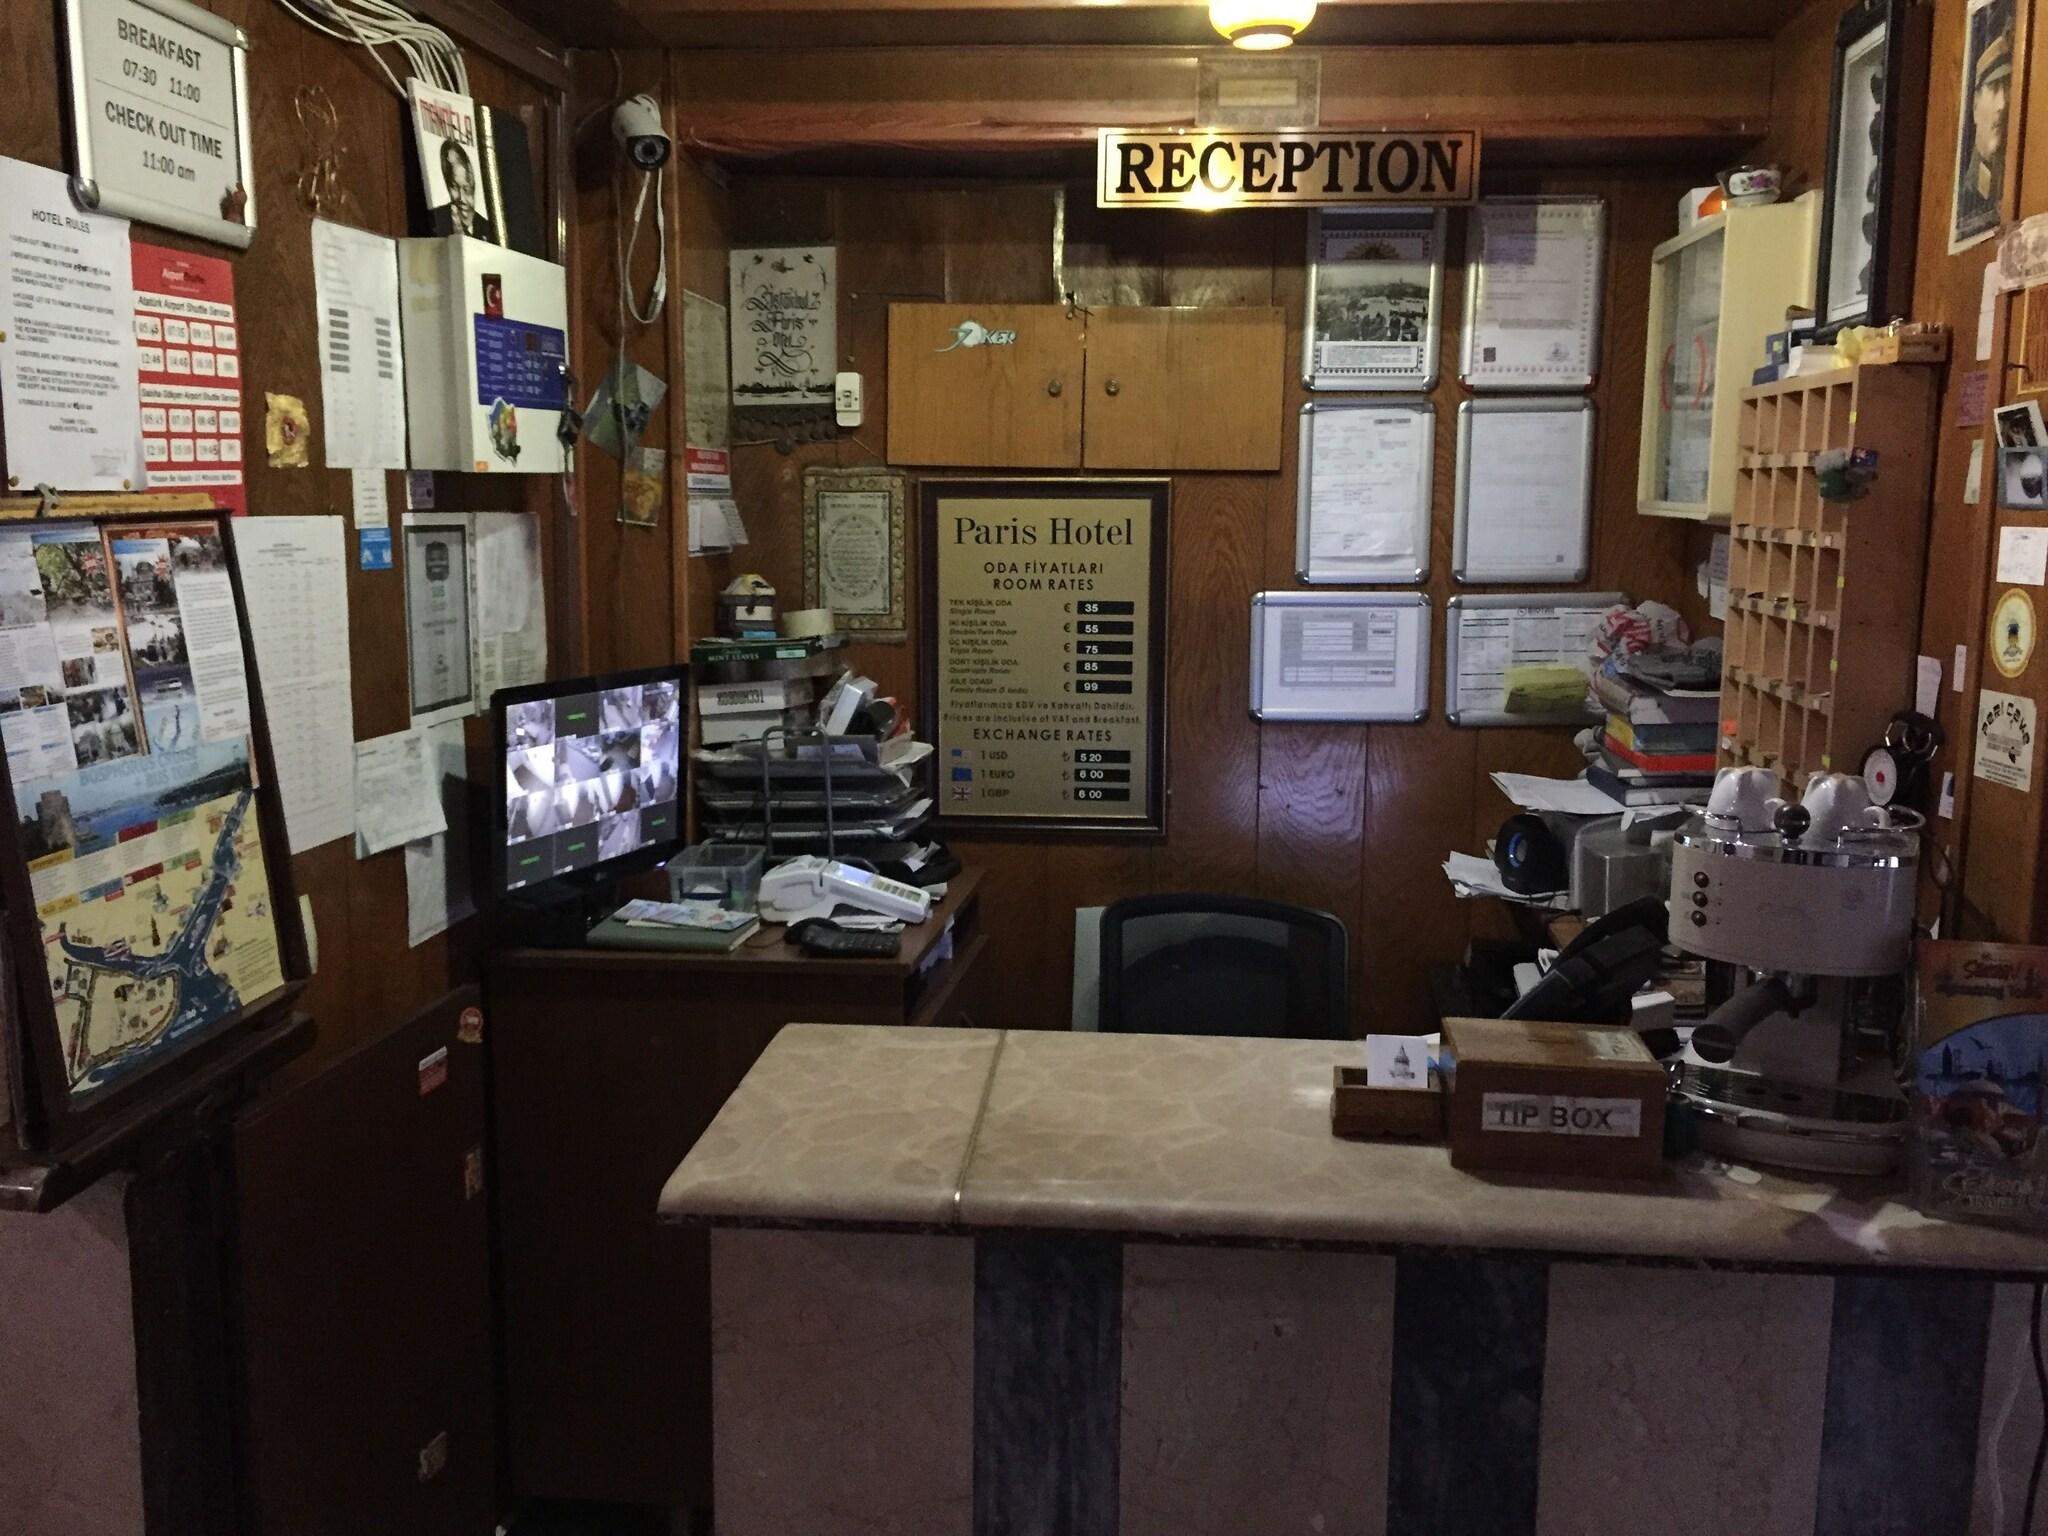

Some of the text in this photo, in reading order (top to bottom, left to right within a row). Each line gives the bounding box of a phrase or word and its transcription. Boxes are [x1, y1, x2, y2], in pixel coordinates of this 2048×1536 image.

[118, 18, 201, 71] BREAKFAST
[123, 58, 200, 103] 07:30 11:00
[105, 101, 223, 159] CHECK OUT TIME
[142, 150, 195, 182] 11:00 am
[1115, 139, 1464, 194] RECEPTION
[32, 209, 90, 234] HOTEL RULES
[164, 299, 184, 311] Airport
[186, 303, 207, 314] Shuttle
[209, 306, 231, 318] Service
[184, 390, 201, 400] Airport
[203, 391, 219, 401] Shuttle
[953, 517, 1133, 545] Paris Hotel
[983, 560, 1103, 574] ODA FİYATLARI
[993, 578, 1094, 591] ROOM RATES
[995, 599, 1012, 607] ODA
[1064, 602, 1099, 613] € 35
[1063, 622, 1099, 633] € 55
[991, 639, 1008, 647] ODA
[1063, 642, 1098, 654] € 75
[1063, 662, 1098, 672] € 85
[1063, 682, 1098, 692] € 99
[1016, 701, 1034, 709] KDV
[943, 714, 972, 722] Prices
[993, 714, 1036, 723] inclusive
[1039, 714, 1049, 723] of
[1052, 714, 1070, 723] VAT
[1072, 715, 1090, 724] and
[973, 728, 1112, 742] EXCHANGE RATES
[989, 752, 1008, 760] USD
[989, 770, 1015, 779] EURO
[987, 789, 1010, 798] GBP
[1497, 1102, 1613, 1129] TIP BOX
